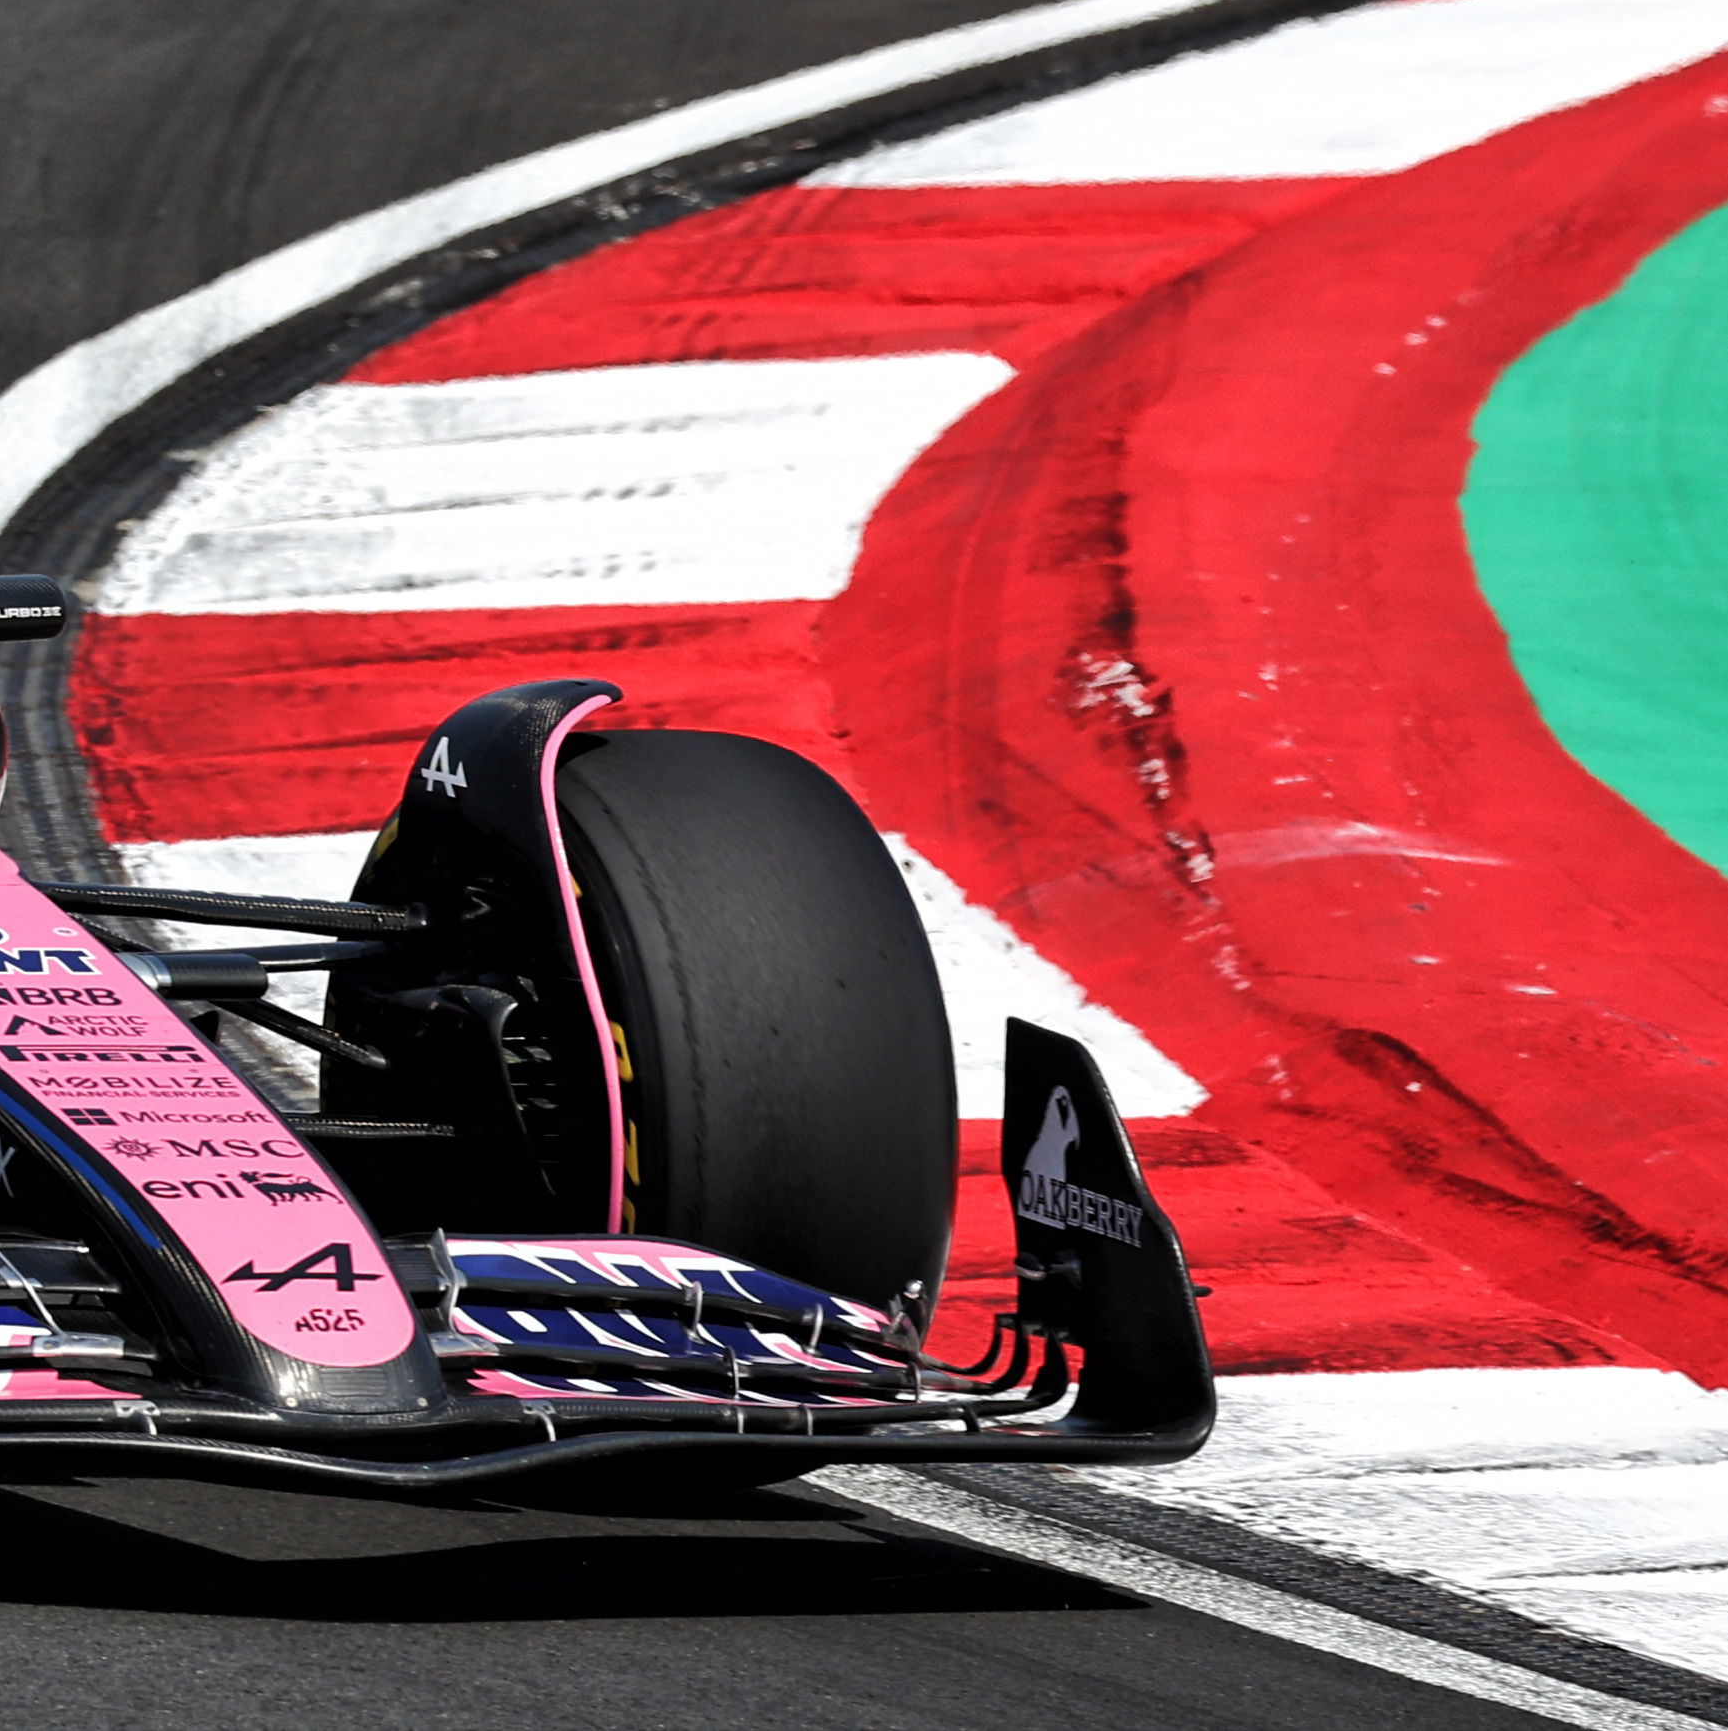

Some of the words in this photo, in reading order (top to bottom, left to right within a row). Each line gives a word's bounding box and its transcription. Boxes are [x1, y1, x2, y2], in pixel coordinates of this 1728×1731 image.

[15, 987, 123, 1007] BRB
[47, 1015, 150, 1026] ARCTIC
[67, 1026, 148, 1038] WOLF
[41, 1090, 143, 1099] FINANCIAL
[149, 1090, 242, 1099] SERVICES
[120, 1109, 274, 1125] Microsoft
[161, 1139, 307, 1159] MSC
[142, 1173, 246, 1199] eni
[1019, 1169, 1144, 1249] OAKBERRY
